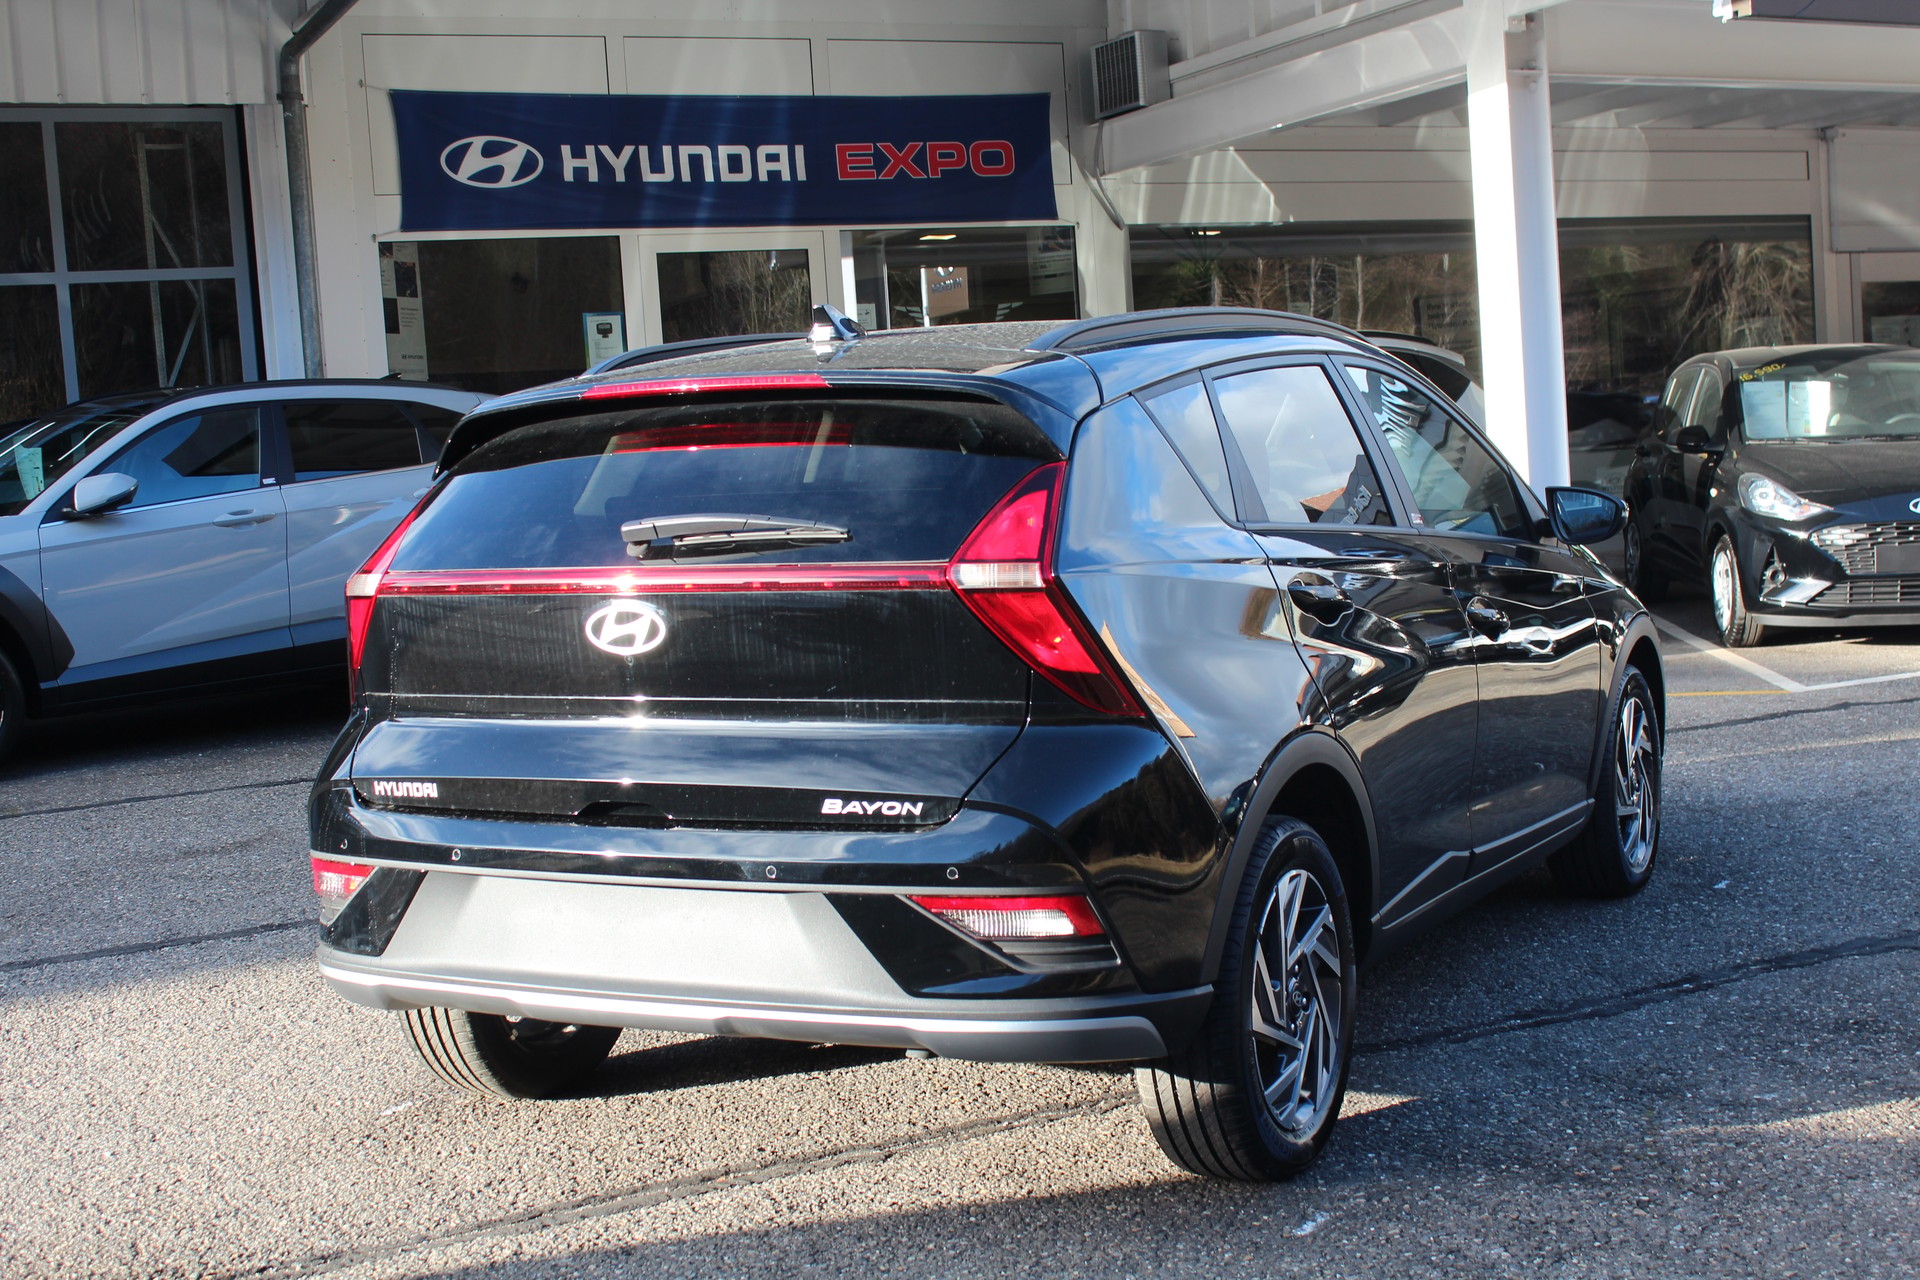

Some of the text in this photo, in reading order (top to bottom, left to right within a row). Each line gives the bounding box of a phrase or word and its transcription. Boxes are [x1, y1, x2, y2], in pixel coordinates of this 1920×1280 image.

[560, 140, 1016, 182] HYUNDAI EXPO
[373, 780, 438, 798] HYUNDAI
[821, 798, 924, 816] BAYON
